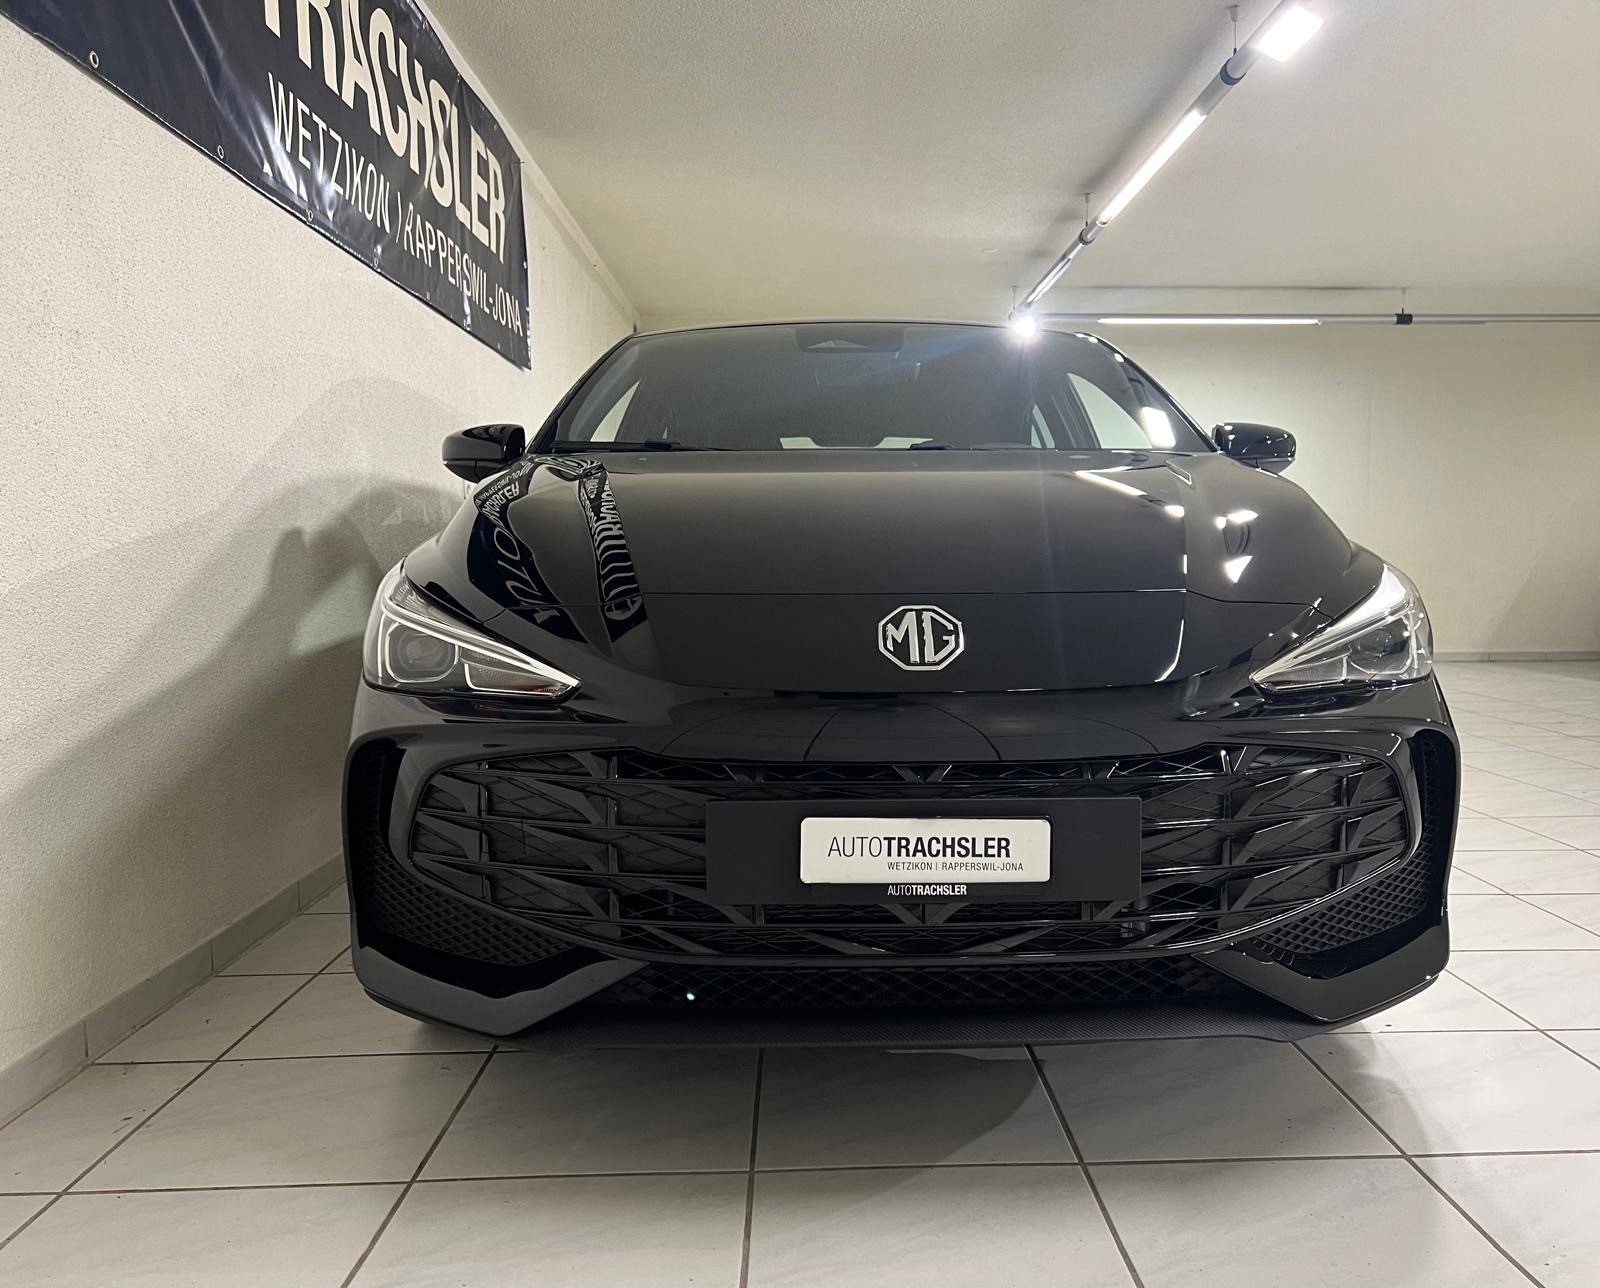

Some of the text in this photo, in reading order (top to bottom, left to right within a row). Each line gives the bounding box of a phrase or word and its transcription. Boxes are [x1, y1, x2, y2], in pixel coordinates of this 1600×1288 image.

[267, 71, 524, 337] WETZIKON RAPPERSWIL-JONA
[885, 610, 956, 664] MG
[827, 836, 1011, 859] AUTOTRACHSLER
[887, 861, 1024, 872] WETZIKON RAPPERSWIL-JONA
[887, 884, 967, 896] AUTOTRACHSLER
